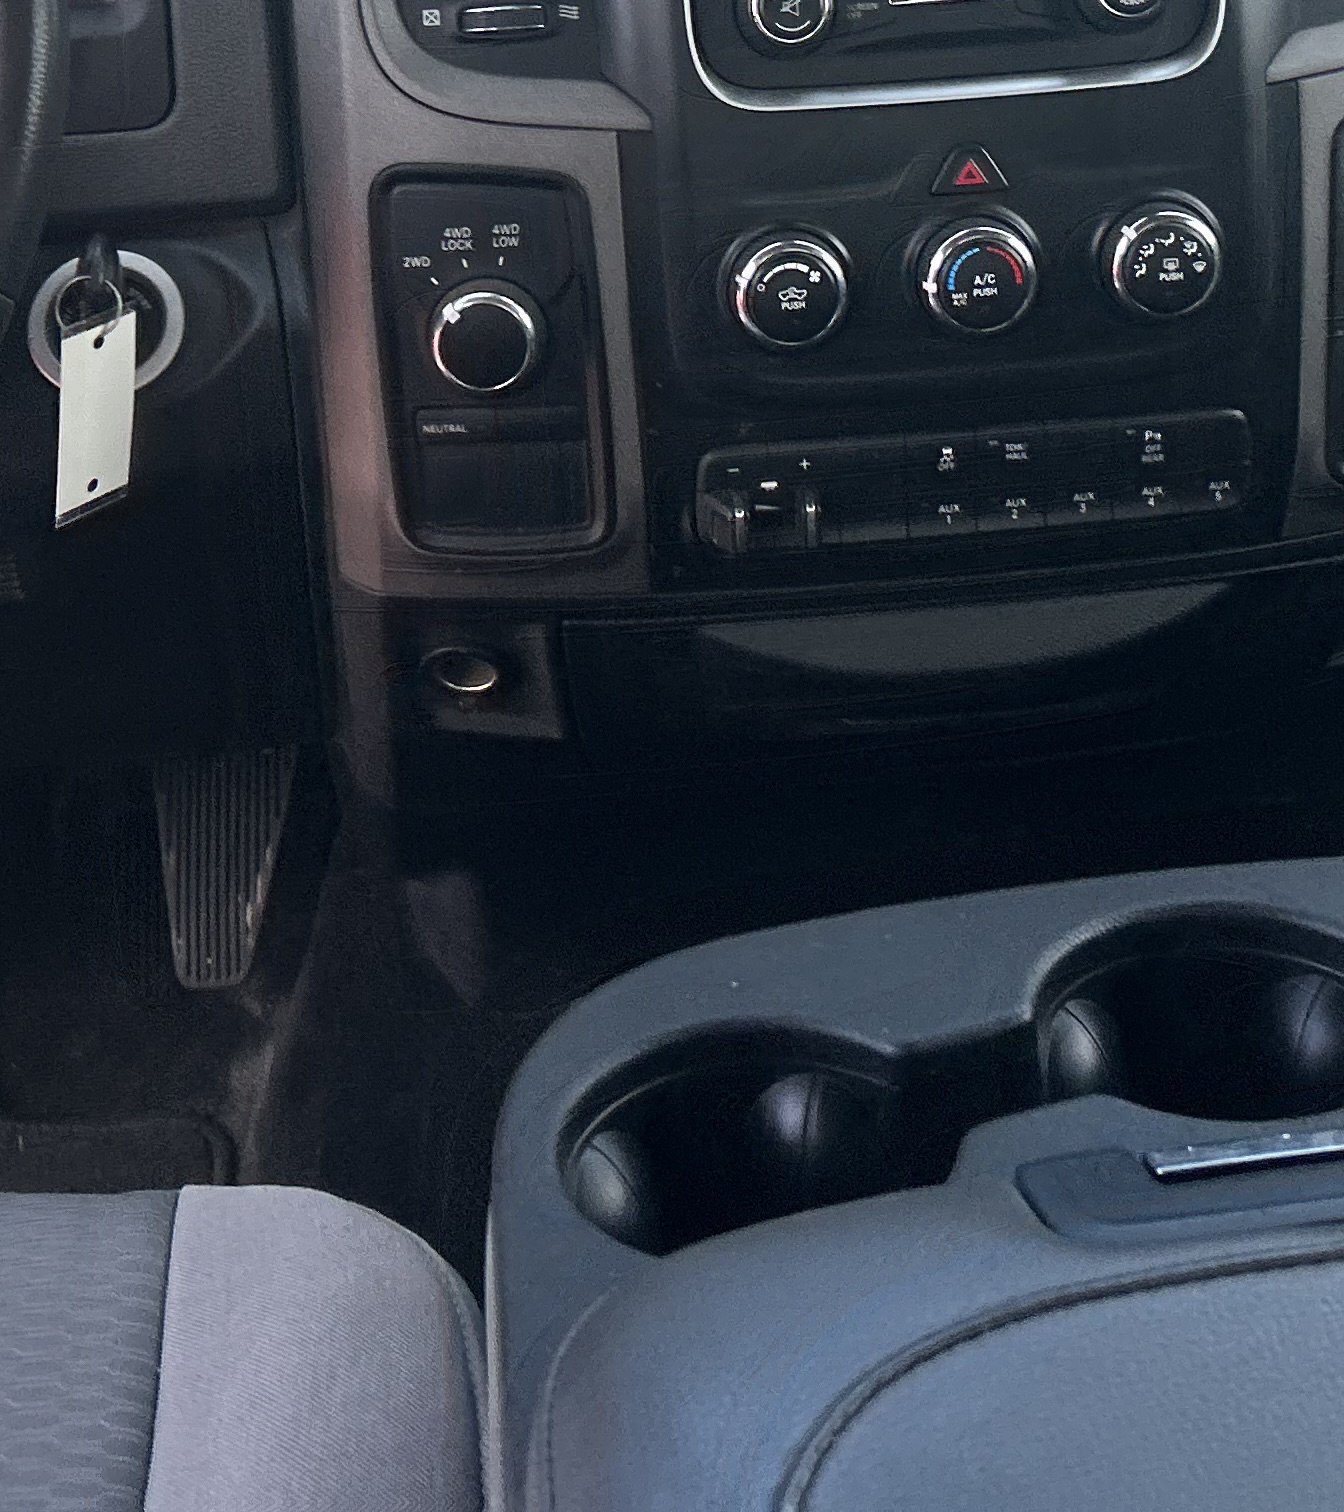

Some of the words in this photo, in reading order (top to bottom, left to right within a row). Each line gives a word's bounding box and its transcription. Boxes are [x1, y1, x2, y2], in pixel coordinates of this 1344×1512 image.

[443, 226, 472, 239] 4WD
[492, 223, 520, 235] 4WD
[441, 239, 474, 251] LOCK
[493, 236, 519, 248] LOW
[403, 256, 431, 268] 2WD
[974, 273, 996, 286] A/C
[1159, 271, 1184, 282] PUSH
[973, 287, 998, 297] PUSH
[781, 301, 806, 311] PUSH
[422, 424, 467, 434] NEUTRAL
[1209, 480, 1231, 490] AUX
[1073, 492, 1095, 501] AUX
[1142, 487, 1164, 496] AUX
[1005, 498, 1026, 508] AUX
[938, 504, 960, 513] AUX
